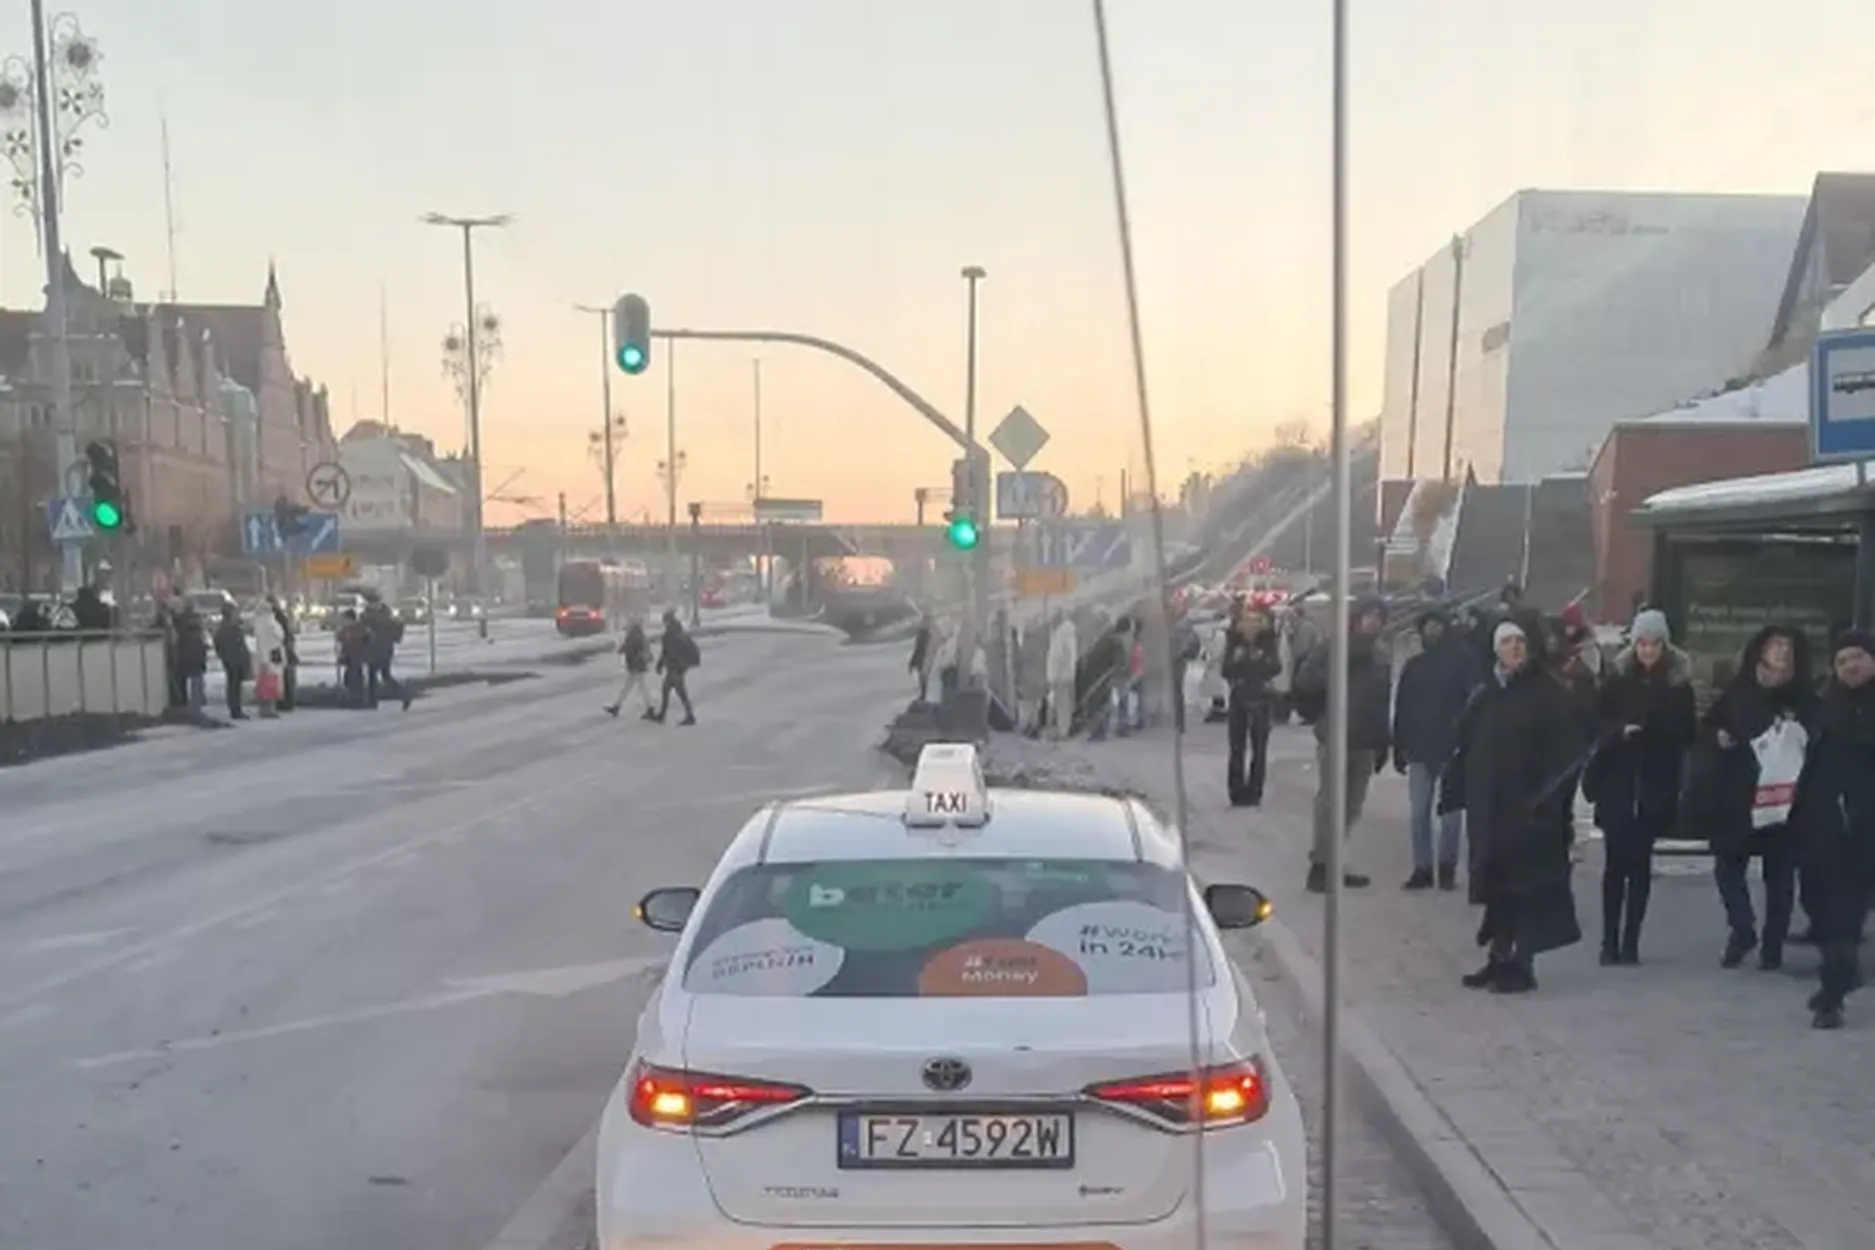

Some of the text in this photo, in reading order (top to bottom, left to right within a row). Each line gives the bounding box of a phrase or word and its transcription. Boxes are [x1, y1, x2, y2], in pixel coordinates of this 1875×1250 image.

[924, 792, 967, 813] TAXI
[867, 1119, 1060, 1157] FZ 4592W
